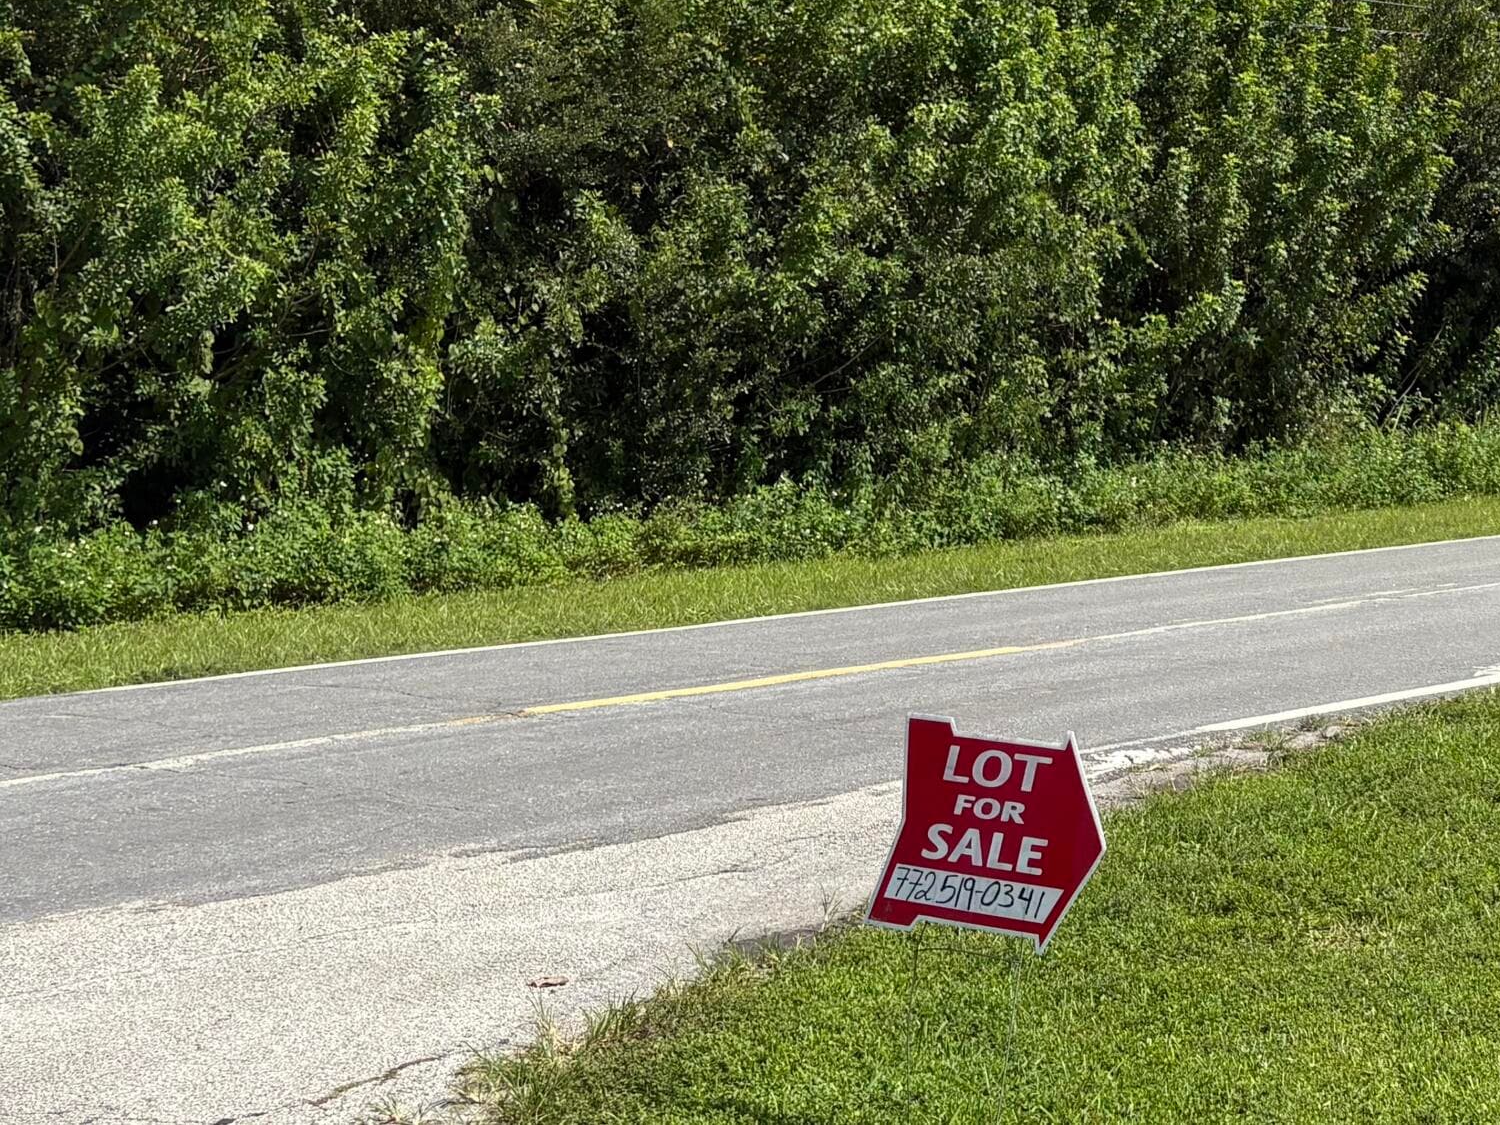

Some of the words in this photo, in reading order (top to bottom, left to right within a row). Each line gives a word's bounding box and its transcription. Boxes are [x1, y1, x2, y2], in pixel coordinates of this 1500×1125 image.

[943, 745, 1053, 792] LOT
[953, 794, 1026, 825] FOR
[921, 823, 1048, 876] SALE
